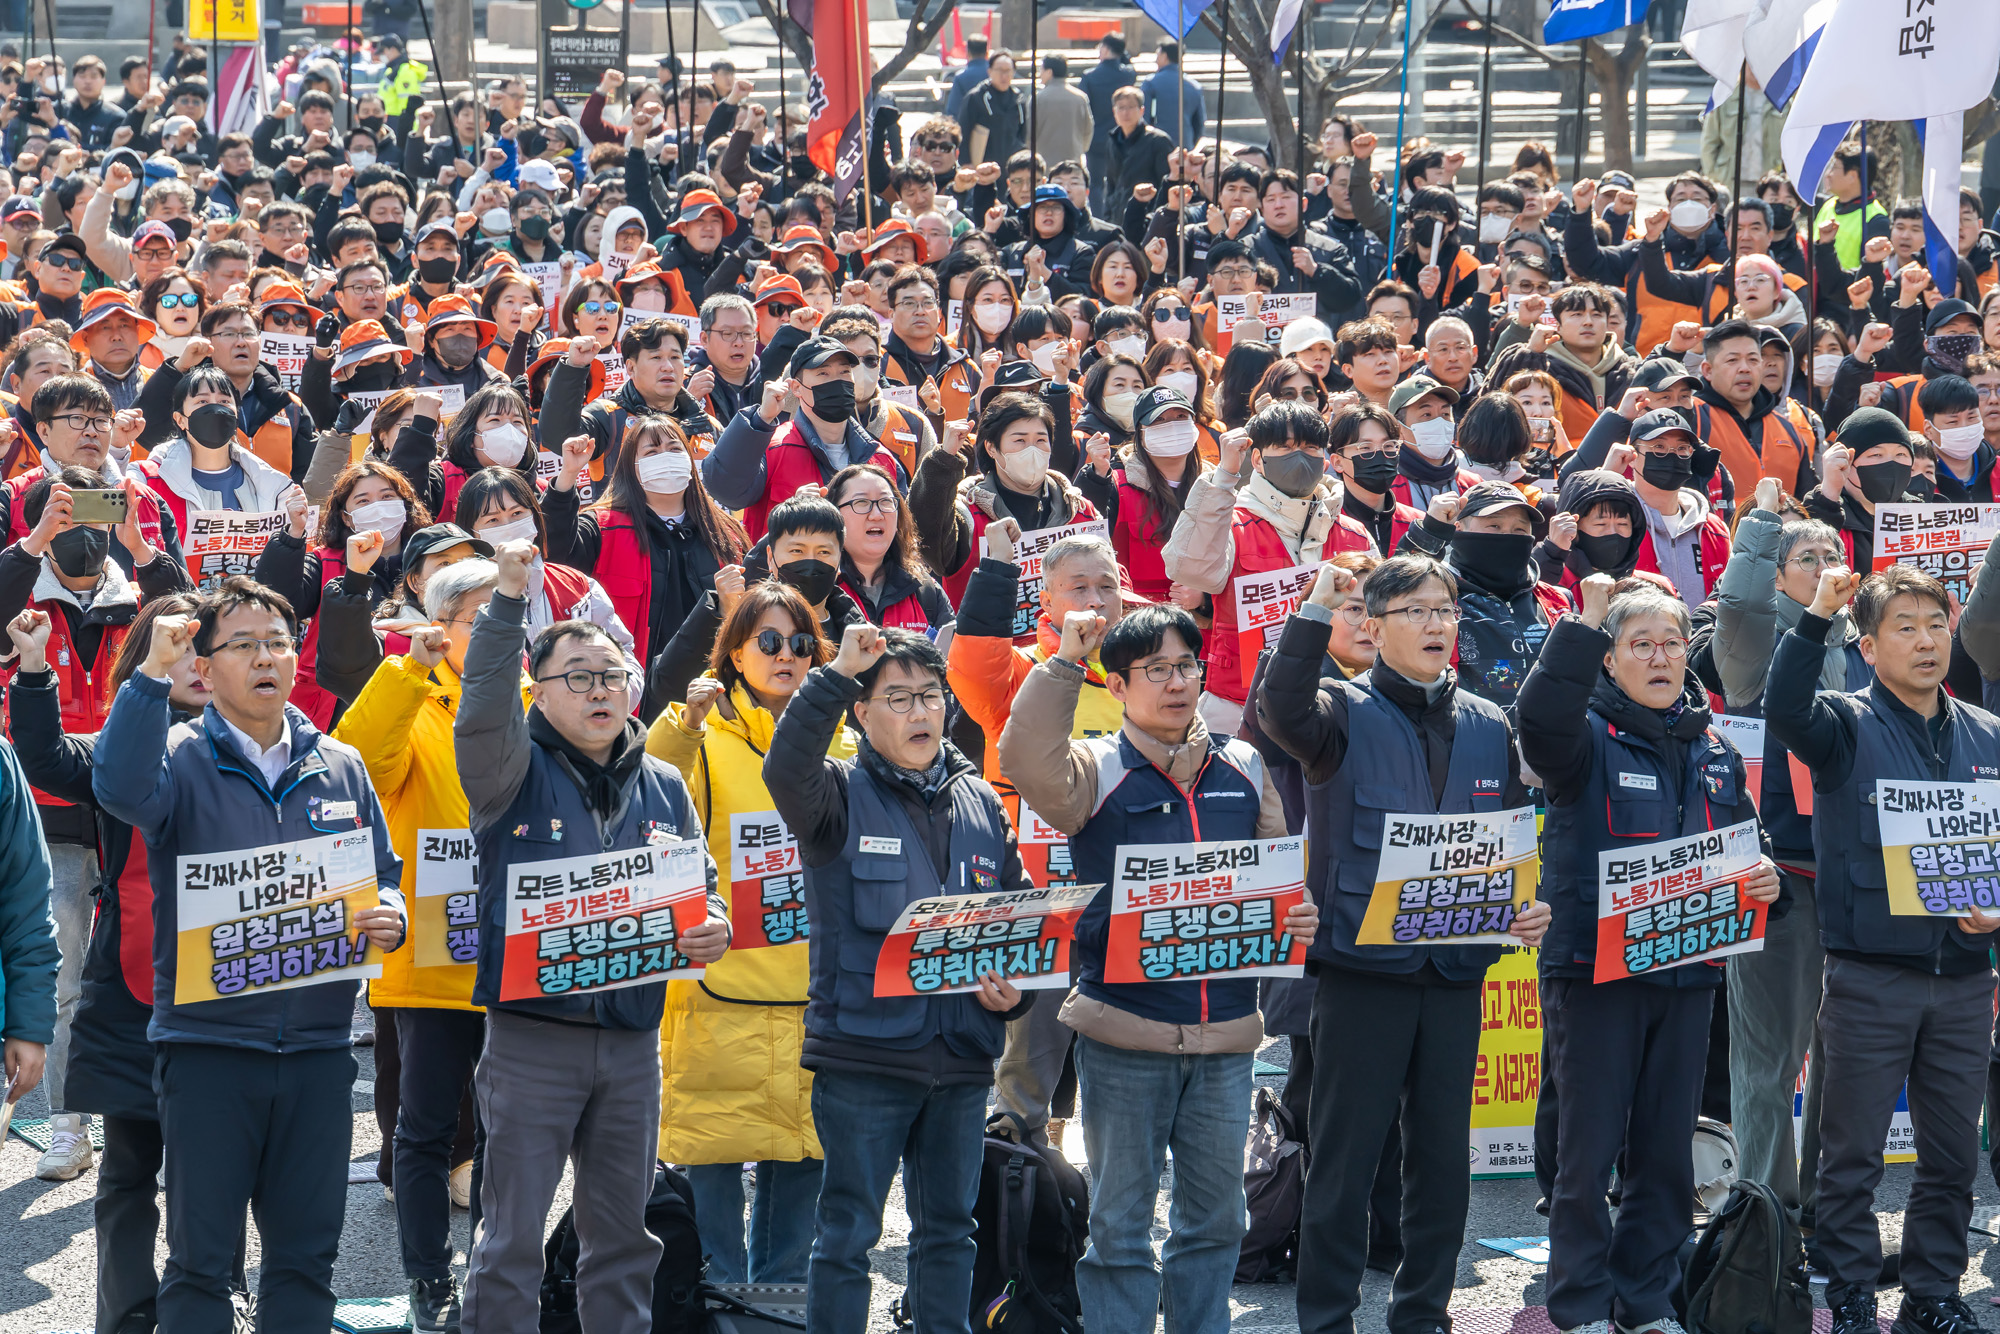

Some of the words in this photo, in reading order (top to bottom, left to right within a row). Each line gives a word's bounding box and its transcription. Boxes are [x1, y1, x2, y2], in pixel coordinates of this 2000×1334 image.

[1222, 302, 1245, 315] 모든
[262, 339, 290, 355] 모든
[192, 519, 224, 534] 모든
[228, 513, 286, 532] 노동자의
[1880, 512, 1914, 532] 모든
[1917, 507, 1979, 529] 노동자의
[1885, 529, 1960, 553] 노동기본권
[1242, 584, 1276, 605] 모든
[1732, 721, 1760, 730] 민주노총
[1708, 764, 1730, 773] 민주노총
[1883, 787, 1964, 813] 진짜사장
[344, 835, 367, 847] 민주노총
[738, 824, 782, 848] 모든
[1277, 842, 1299, 851] 민주노총
[1389, 820, 1477, 848] 진짜사장
[671, 846, 698, 857] 민주노총
[1122, 857, 1168, 881] 모든
[1174, 845, 1259, 876] 노동자의
[1430, 837, 1503, 871] 나와라!
[1605, 859, 1648, 884] 모든
[1651, 834, 1724, 875] 노동자의
[185, 851, 287, 890] 진짜사장
[515, 874, 564, 900] 모든
[570, 852, 654, 893] 노동자의
[239, 866, 327, 912] 나와라!
[909, 902, 958, 914] 모든
[965, 890, 1050, 909] 노동자의
[1127, 875, 1232, 908] 노동기본권
[1400, 869, 1513, 910] 원청교섭
[1612, 866, 1703, 911] 노동기본권
[522, 886, 632, 929] 노동기본권
[906, 905, 1015, 930] 노동기본권
[1140, 897, 1274, 943] 투쟁으로
[1624, 882, 1738, 939] 투쟁으로
[211, 898, 346, 959] 원청교섭
[537, 907, 675, 962] 투쟁으로
[911, 916, 1044, 954] 투쟁으로
[1624, 909, 1757, 973] 쟁취하자!
[211, 931, 369, 995] 쟁취하자!
[907, 938, 1057, 993] 쟁취하자!
[1139, 932, 1293, 979] 쟁취하자!
